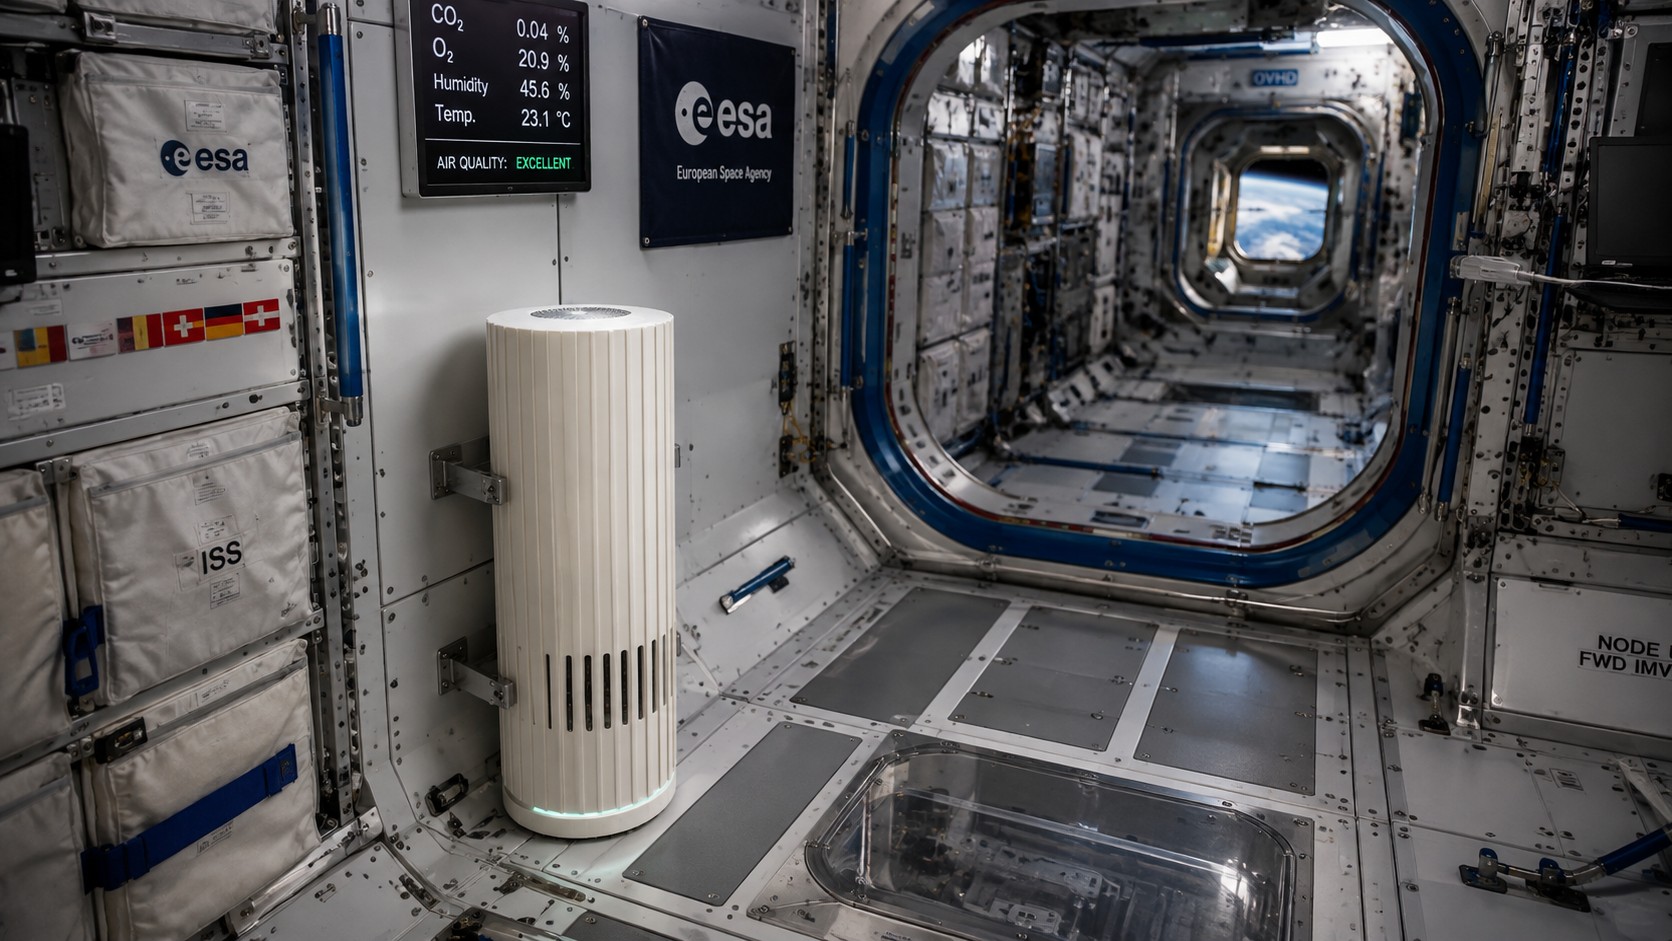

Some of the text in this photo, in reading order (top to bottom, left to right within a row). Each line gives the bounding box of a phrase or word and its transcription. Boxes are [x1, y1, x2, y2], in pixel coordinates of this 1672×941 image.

[517, 18, 548, 41] 0.04
[557, 25, 570, 44] %
[518, 48, 549, 70] 20.9
[557, 54, 570, 73] %
[433, 73, 571, 101] Humidity 45.6 %
[1253, 71, 1297, 86] OVHD
[434, 104, 571, 128] Temp. 23.1 °C
[717, 98, 773, 139] esa
[195, 148, 249, 171] esa
[437, 156, 572, 170] AIR QUALITY: EXCELLENT
[676, 164, 772, 183] European Space Agency
[201, 540, 242, 575] ISS
[1598, 634, 1660, 658] NODE
[1579, 650, 1672, 678] FWD IMV
